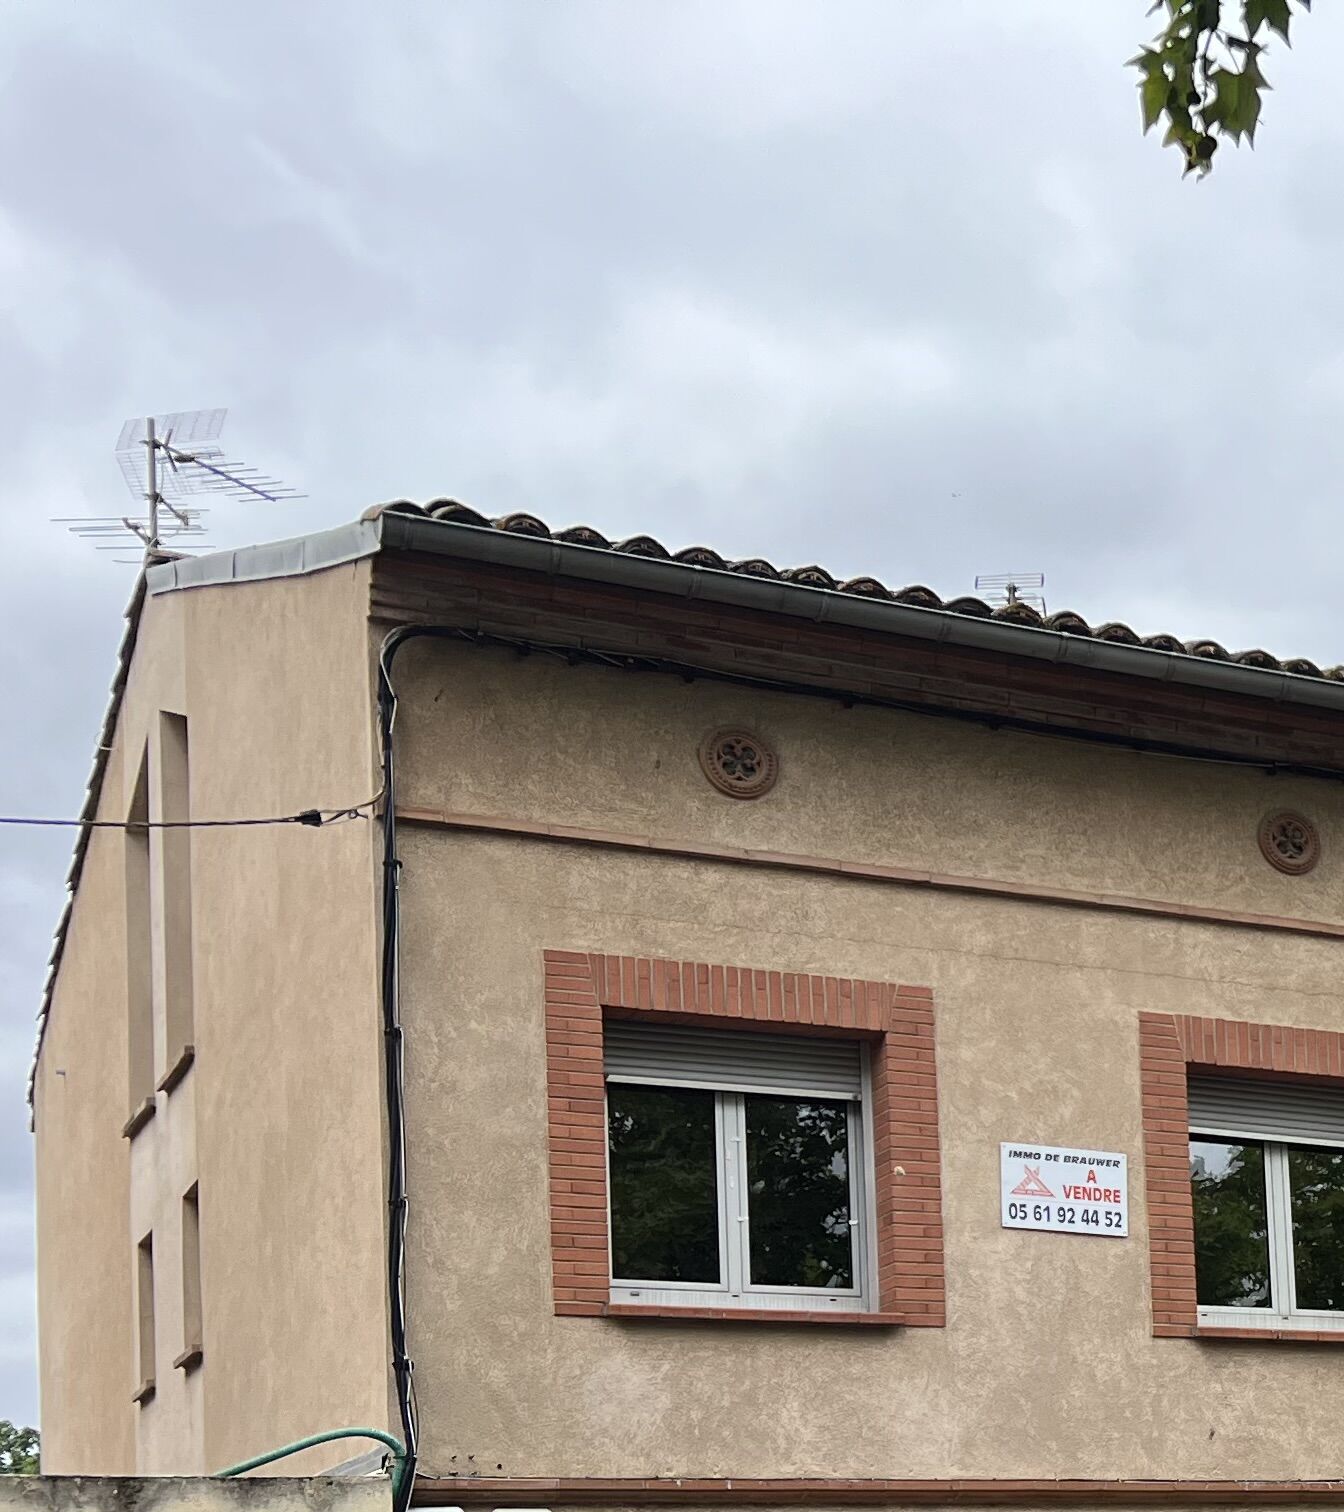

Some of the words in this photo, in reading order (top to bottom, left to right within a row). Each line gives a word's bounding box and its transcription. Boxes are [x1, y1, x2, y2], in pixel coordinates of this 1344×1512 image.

[1008, 1150, 1041, 1160] IMMO
[1044, 1153, 1060, 1163] DE
[1063, 1155, 1121, 1168] BRAUWER
[1086, 1169, 1097, 1184] A
[1062, 1184, 1121, 1204] VENDRE
[1008, 1203, 1028, 1221] 05
[1033, 1204, 1051, 1222] 61
[1057, 1206, 1076, 1224] 92
[1081, 1208, 1100, 1226] 44
[1104, 1210, 1122, 1229] 52
